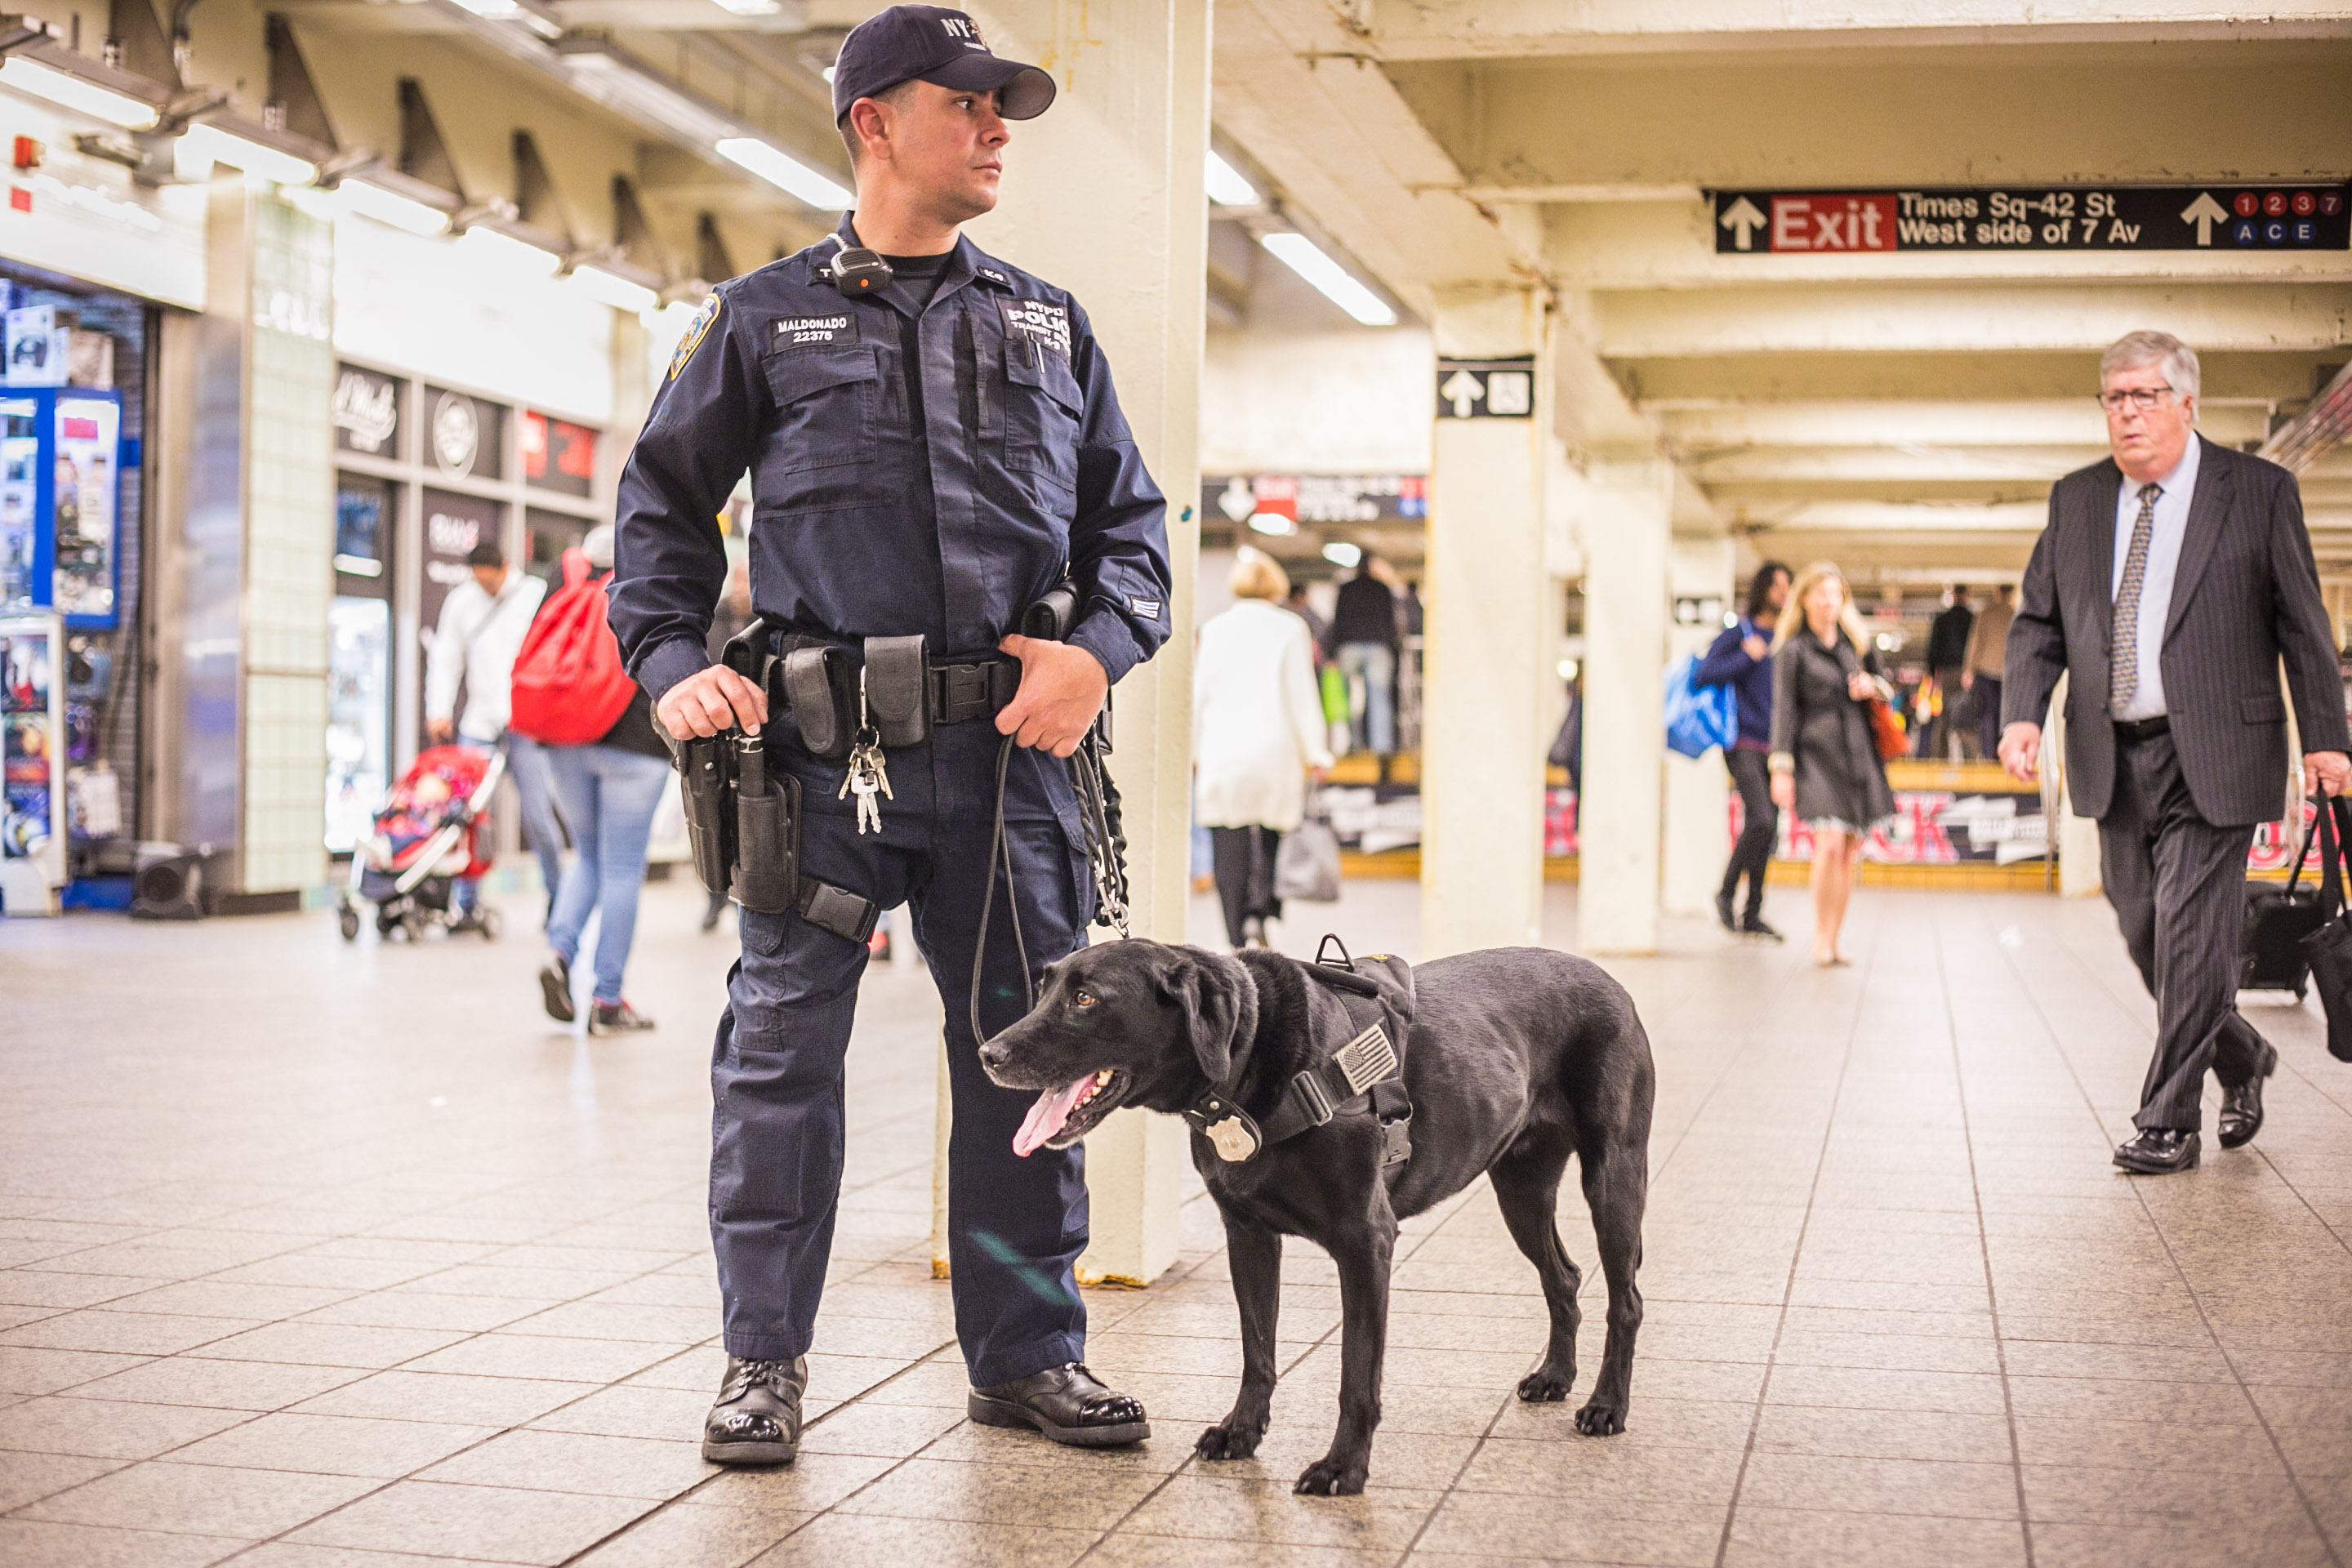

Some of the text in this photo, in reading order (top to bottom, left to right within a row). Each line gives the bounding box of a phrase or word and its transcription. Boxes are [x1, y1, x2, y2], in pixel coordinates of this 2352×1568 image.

[1897, 191, 2117, 222] Times Sq-42 St
[2241, 196, 2336, 212] 1 2 3 7
[1773, 198, 1883, 248] Exit
[1897, 217, 2141, 244] West side of 7 Av
[2239, 224, 2310, 240] A C E
[819, 268, 832, 278] T
[1023, 300, 1065, 317] NYPD
[777, 316, 848, 334] MALDONADO
[1006, 308, 1071, 345] POLIC
[1010, 320, 1053, 337] TRANSIT
[792, 330, 834, 344] 22375
